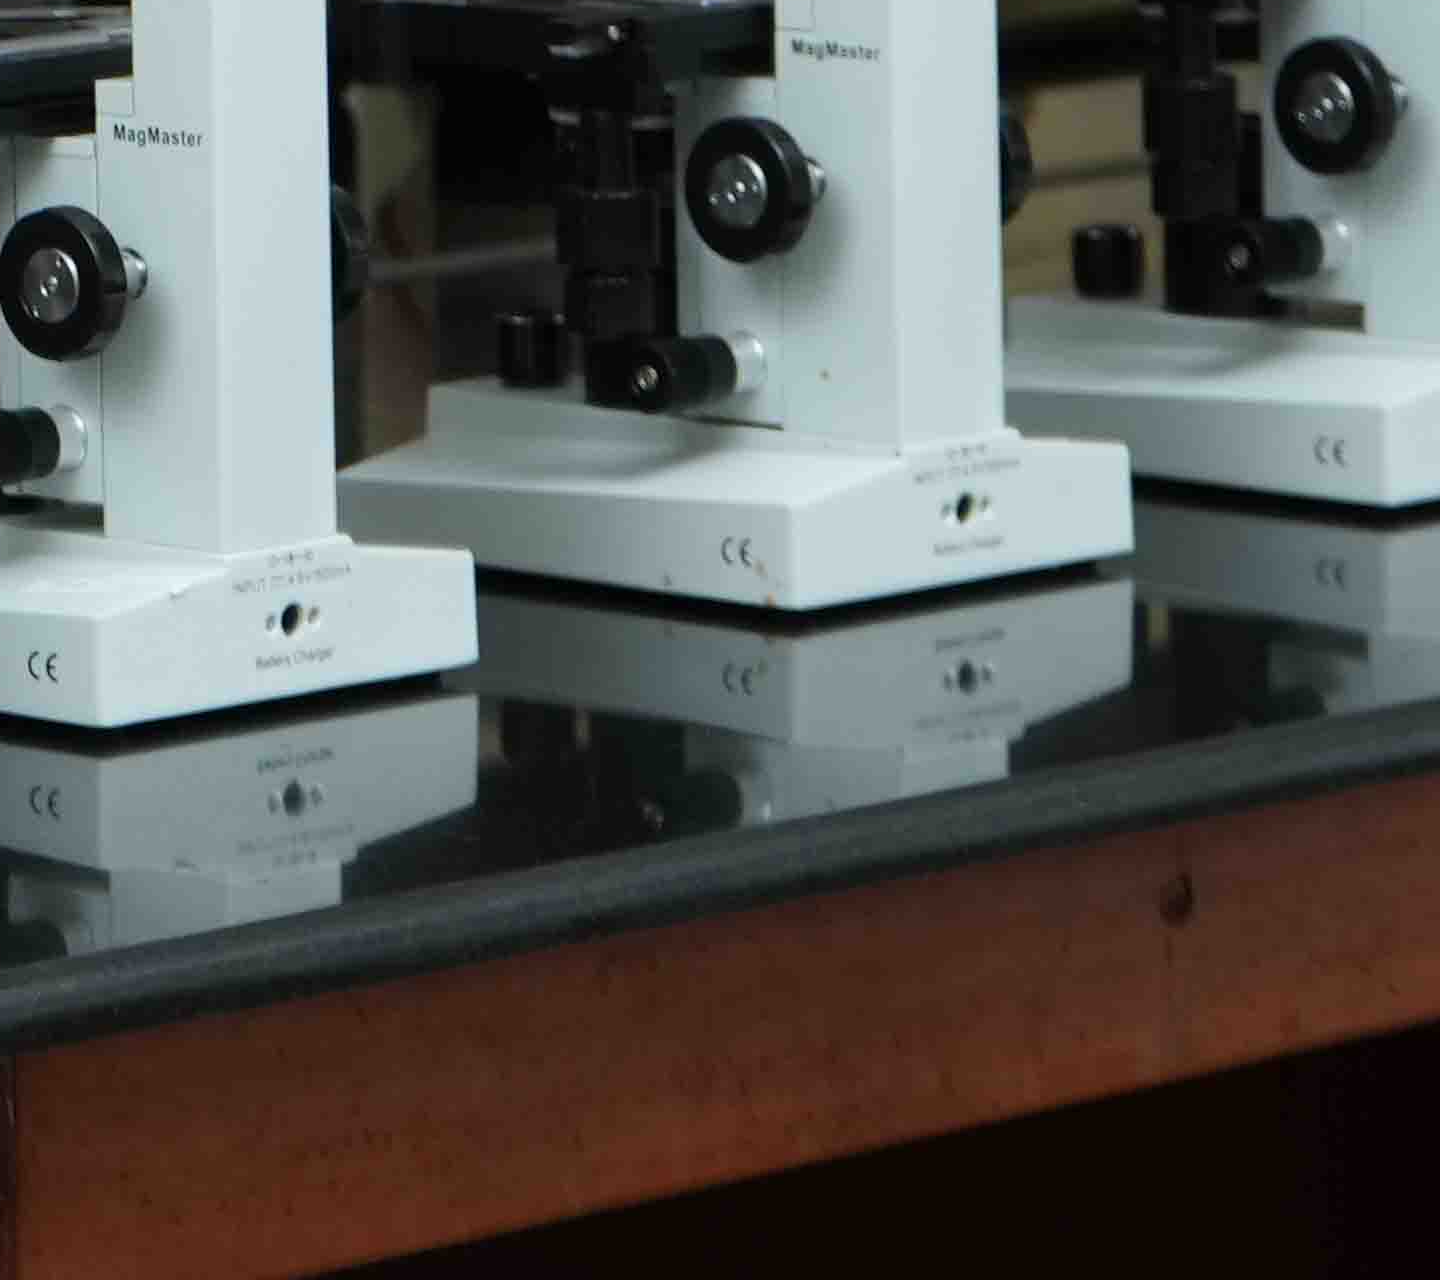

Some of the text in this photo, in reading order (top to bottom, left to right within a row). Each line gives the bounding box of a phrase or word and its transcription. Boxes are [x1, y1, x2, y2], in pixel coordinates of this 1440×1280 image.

[113, 123, 203, 147] MagMaster
[721, 537, 752, 567] CE
[28, 650, 59, 684] CE
